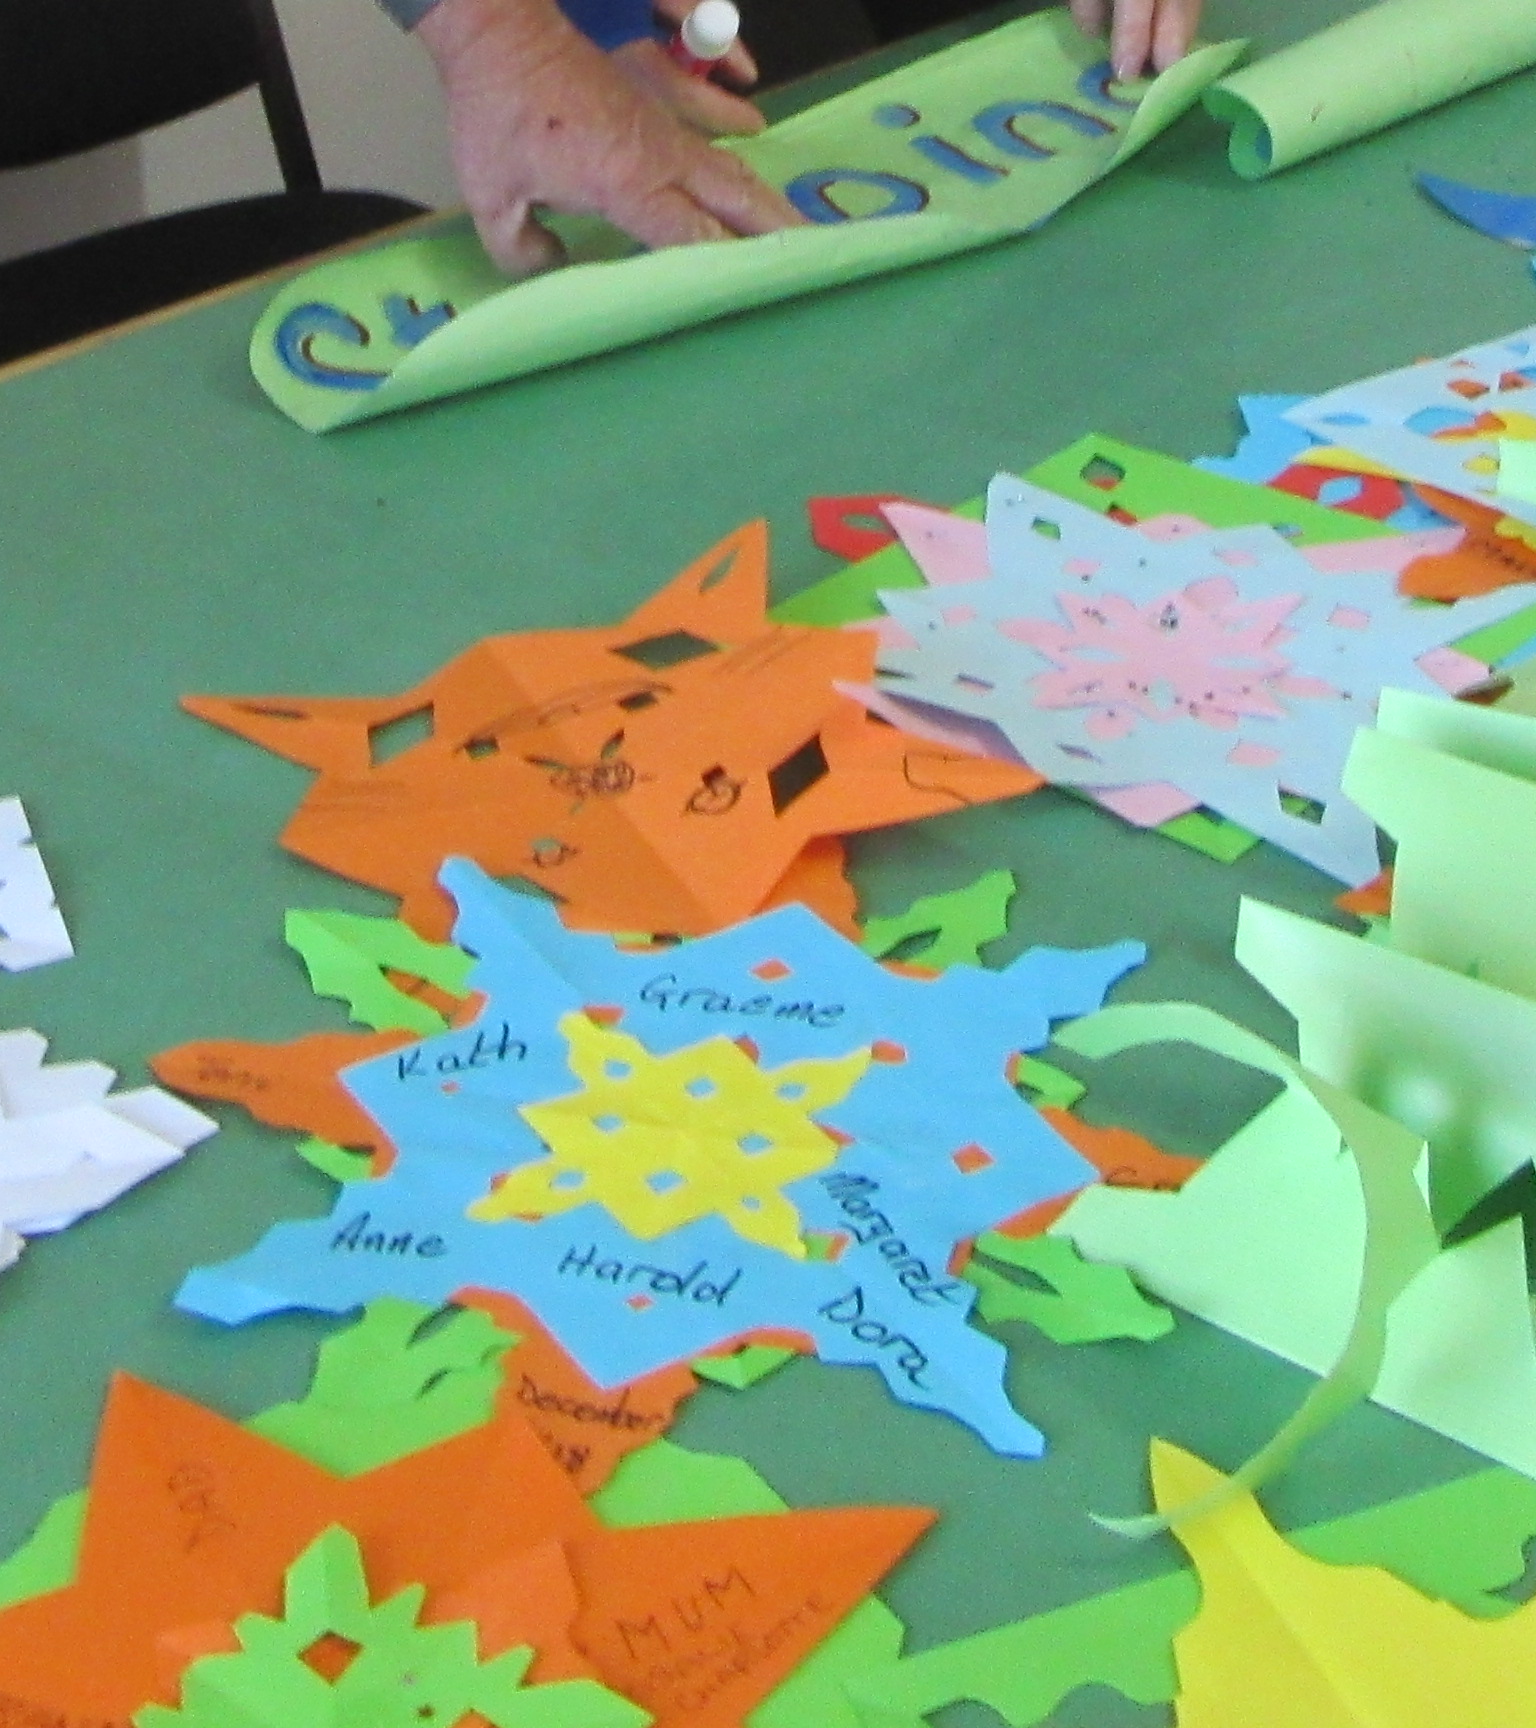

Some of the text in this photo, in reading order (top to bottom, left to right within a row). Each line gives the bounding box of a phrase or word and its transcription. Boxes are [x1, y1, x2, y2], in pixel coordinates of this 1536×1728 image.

[640, 973, 845, 1028] Graeme
[397, 1022, 527, 1080] Kath
[330, 1211, 447, 1258] Anne
[819, 1171, 961, 1307] Margaret
[558, 1244, 742, 1306] Harold
[818, 1285, 930, 1390] Dora
[615, 1565, 757, 1659] MUM
